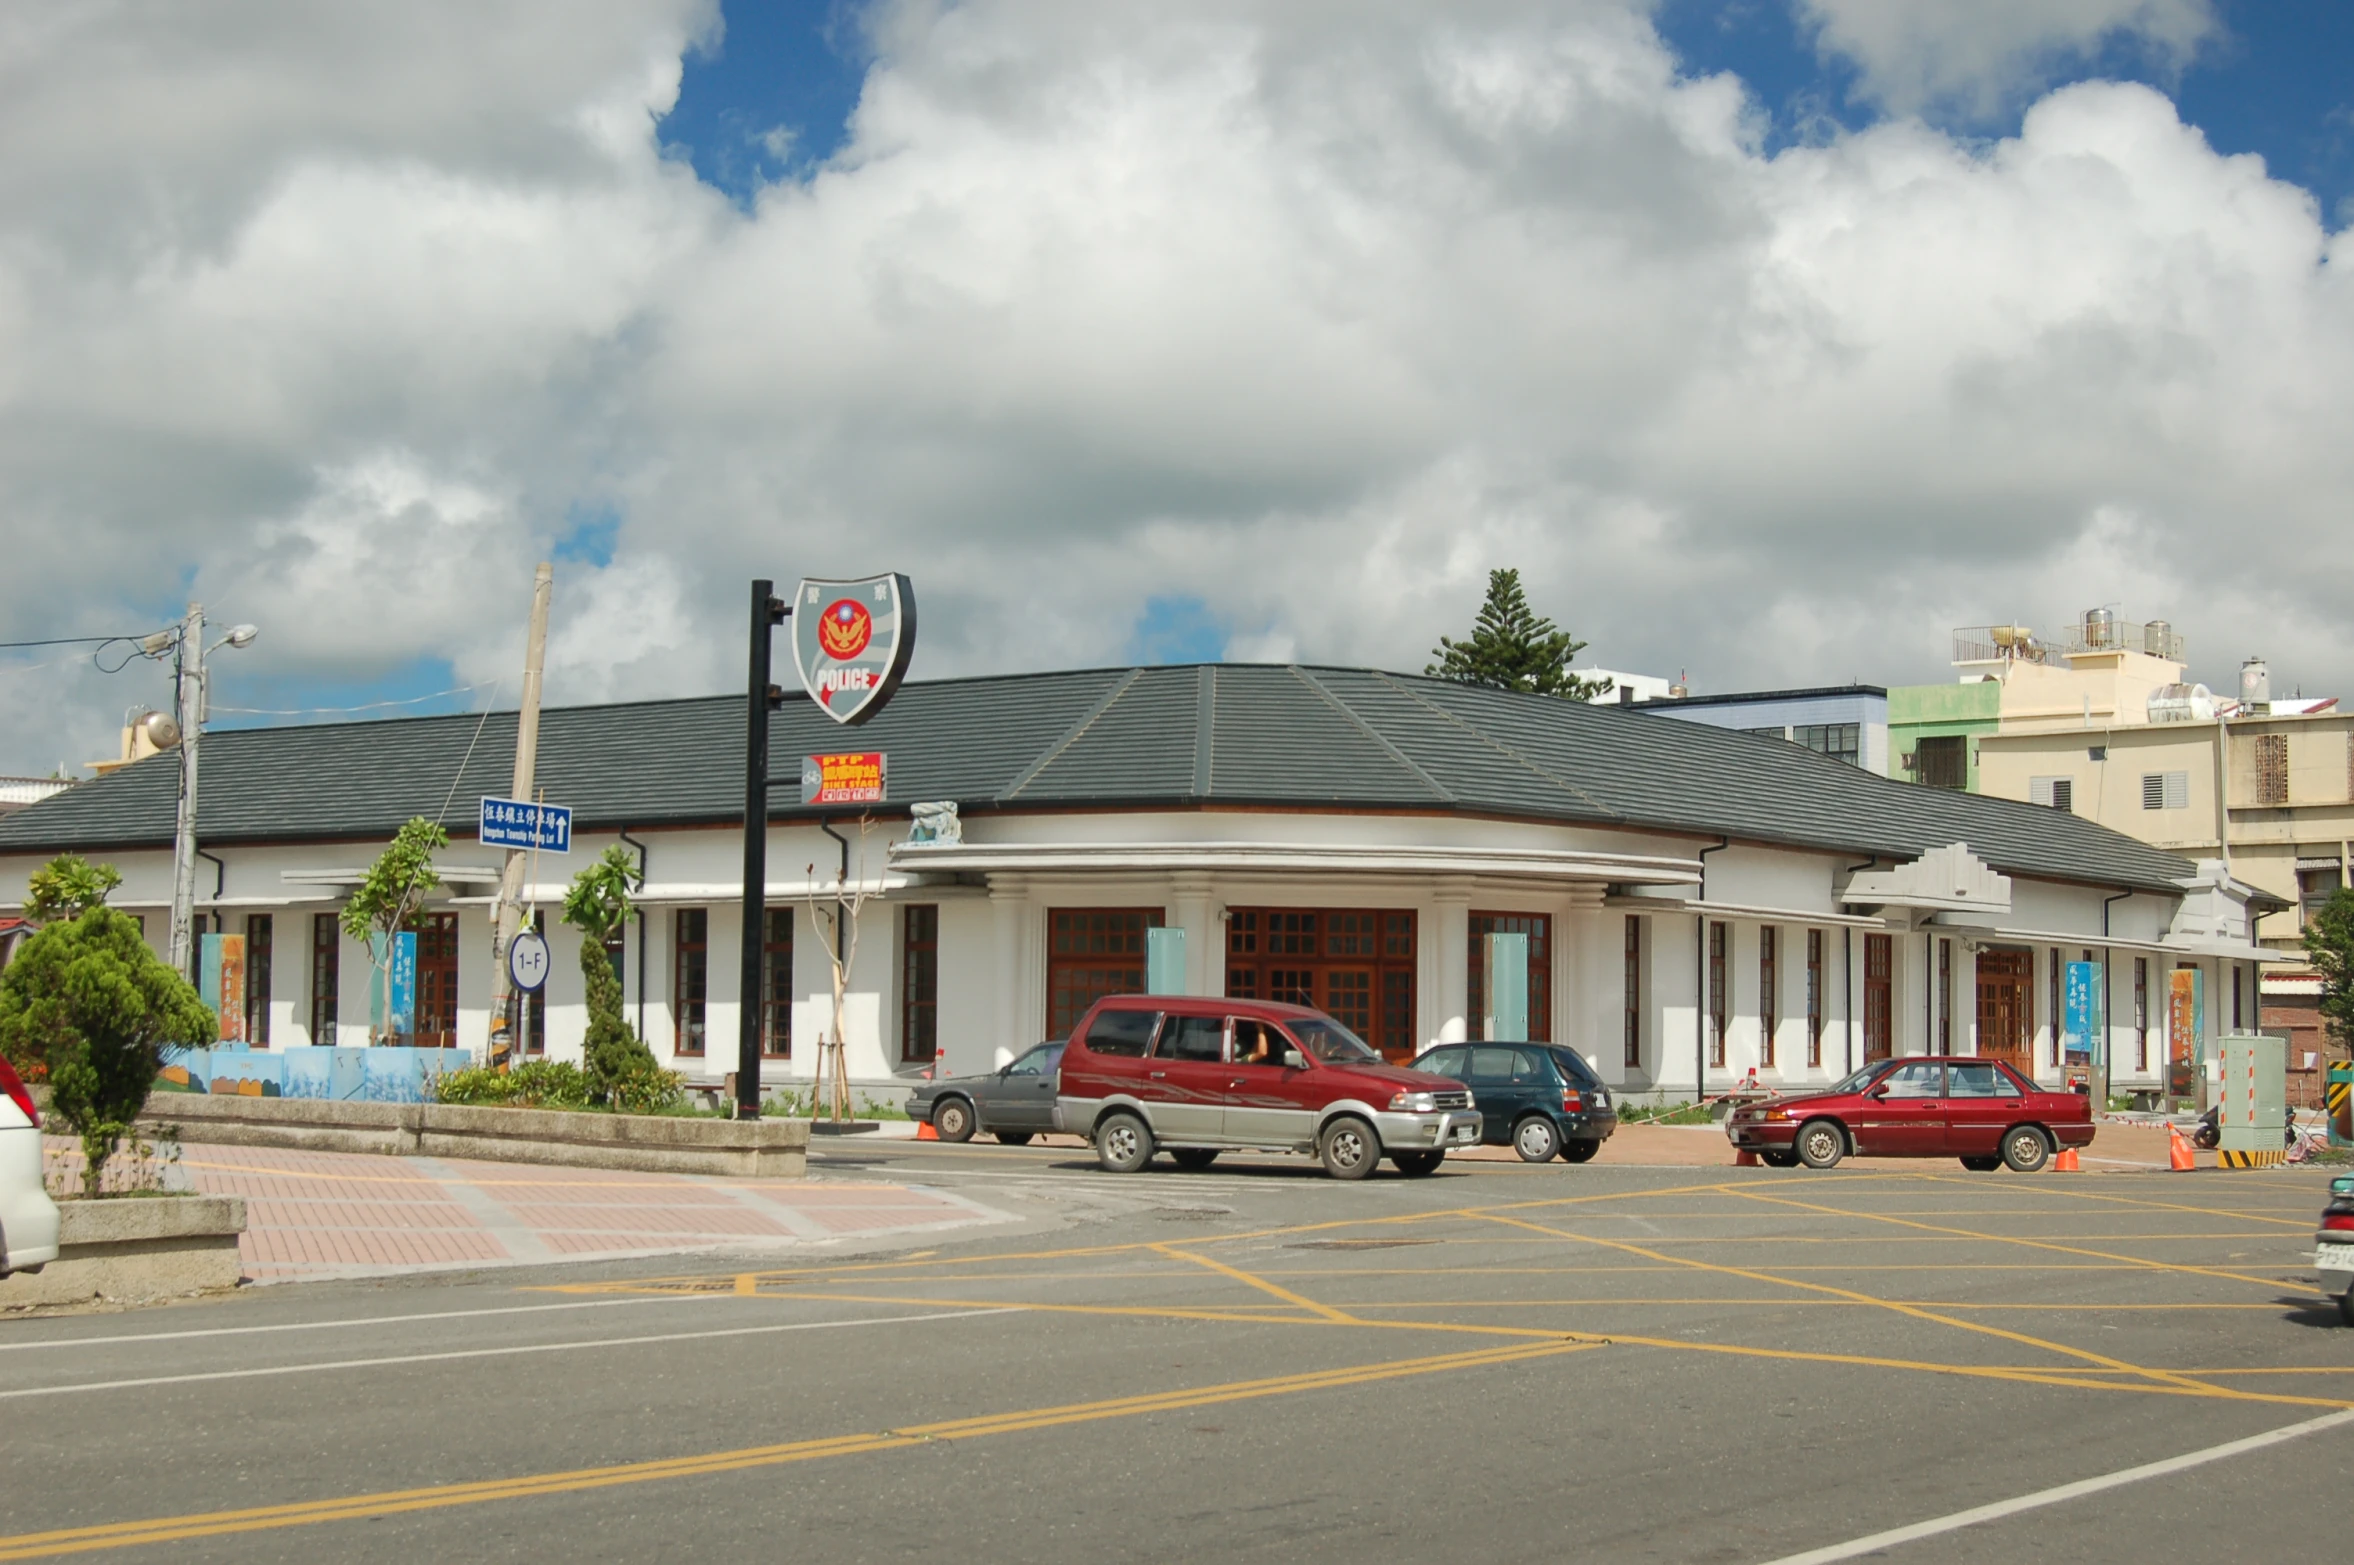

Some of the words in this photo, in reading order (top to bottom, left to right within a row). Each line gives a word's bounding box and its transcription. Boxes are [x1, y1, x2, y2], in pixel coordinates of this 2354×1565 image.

[874, 583, 887, 602] 察
[817, 667, 871, 692] POLICE
[823, 755, 864, 766] PTP
[823, 781, 847, 789] BIKE
[506, 828, 527, 843] Township
[546, 833, 555, 844] Lot
[519, 952, 541, 970] 1-F
